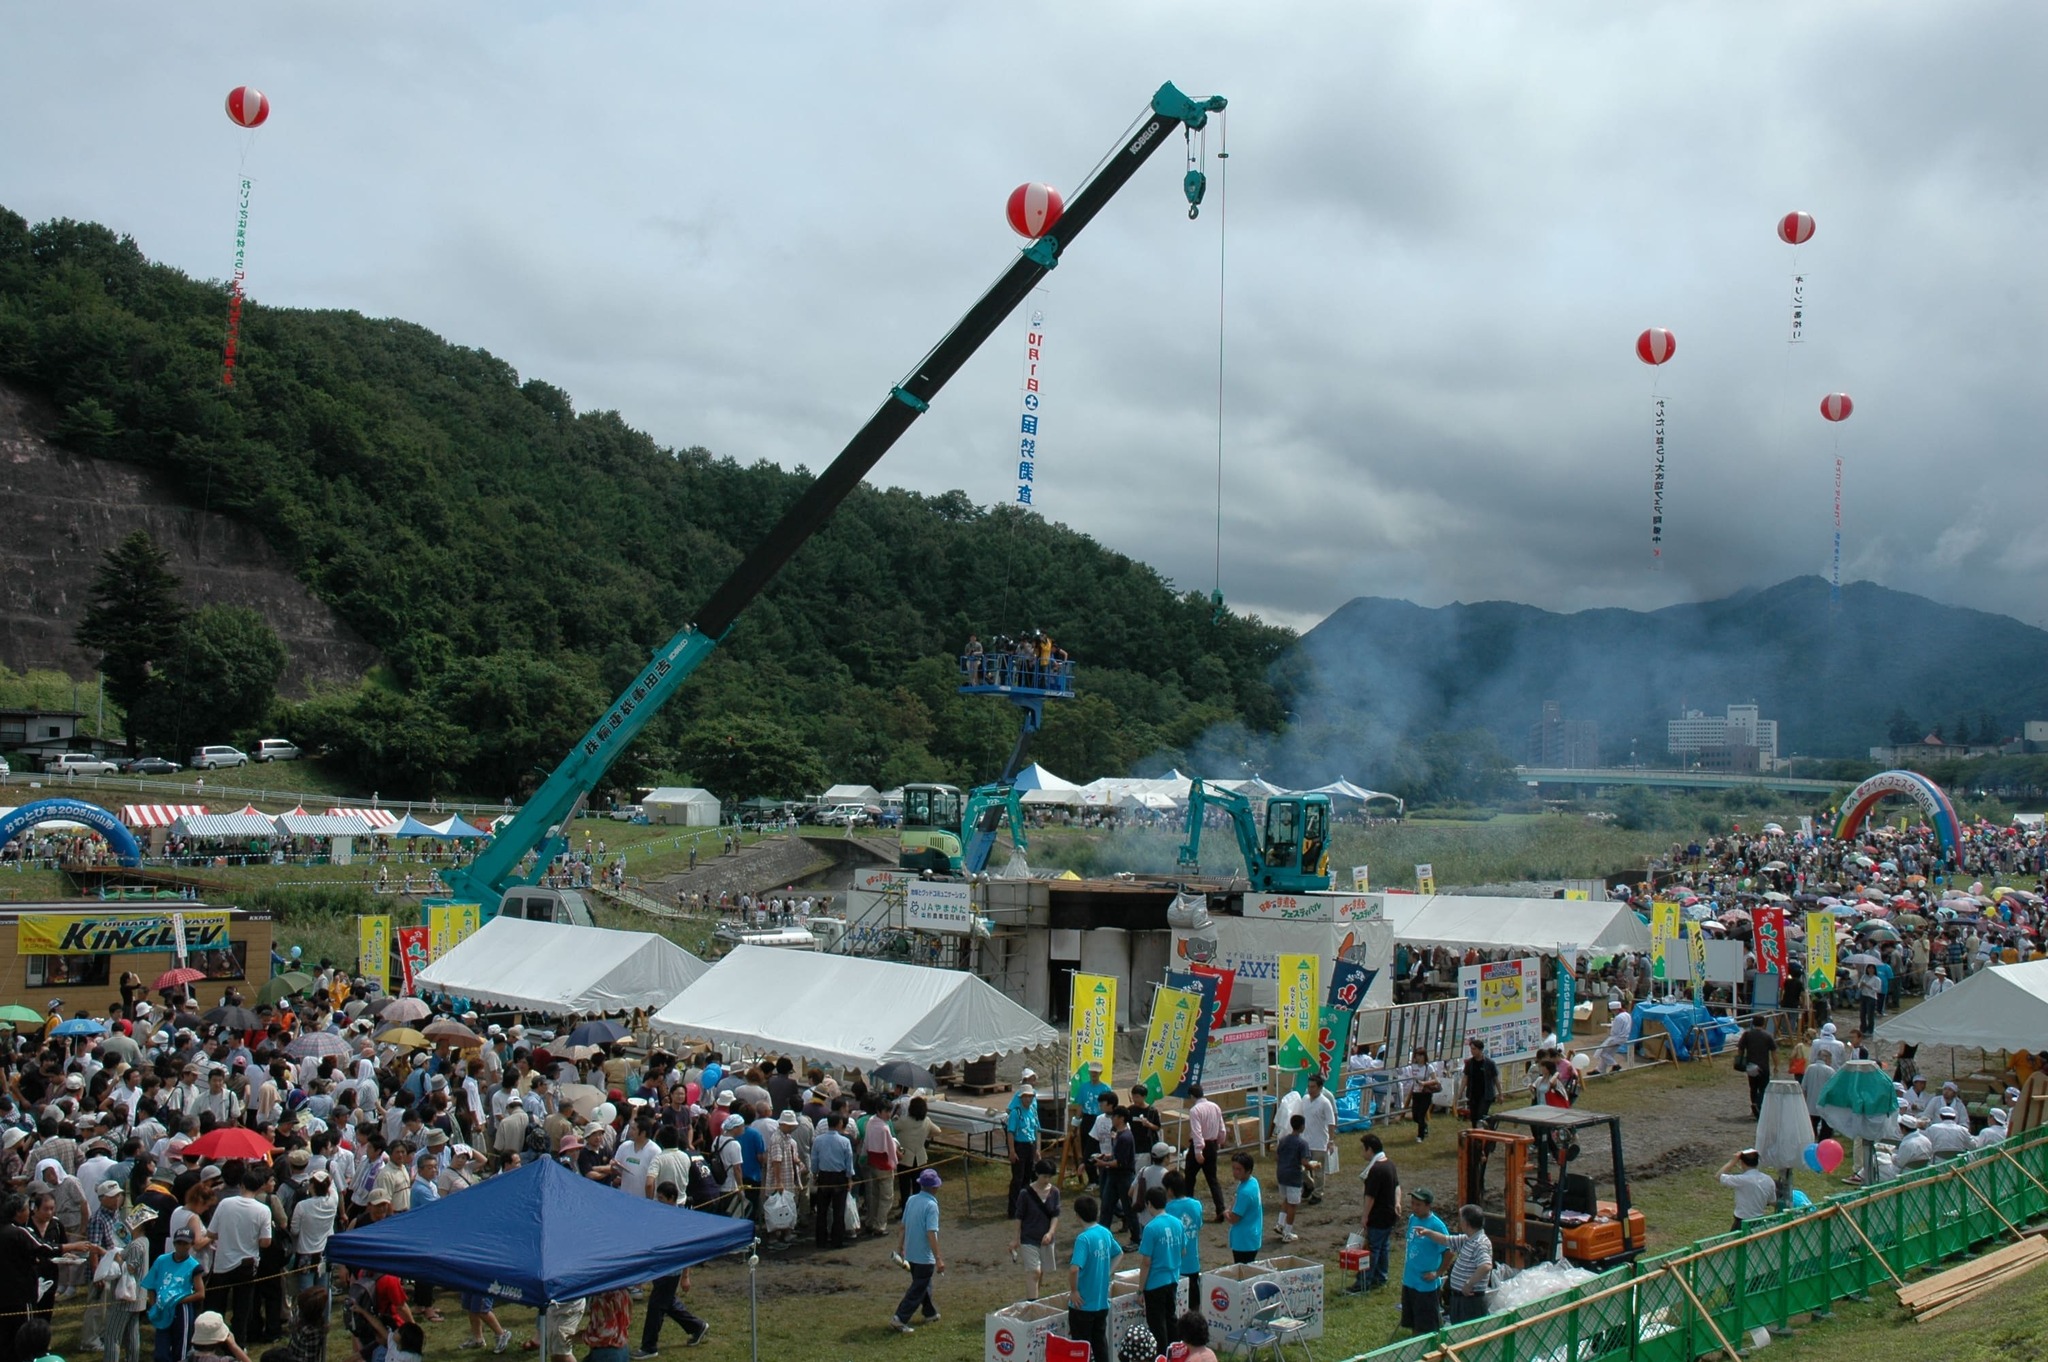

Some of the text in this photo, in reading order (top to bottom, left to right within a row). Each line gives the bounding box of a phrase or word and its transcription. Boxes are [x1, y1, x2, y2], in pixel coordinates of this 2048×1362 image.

[1129, 121, 1160, 155] KOBELCO
[152, 917, 224, 926] EXCVATOR
[1281, 902, 1322, 918] フェスティバル
[59, 921, 225, 951] KINGLEV
[1298, 973, 1309, 1031] おいしい山形
[1093, 996, 1106, 1059] おいしい山形
[1163, 1011, 1186, 1072] おいしい山形
